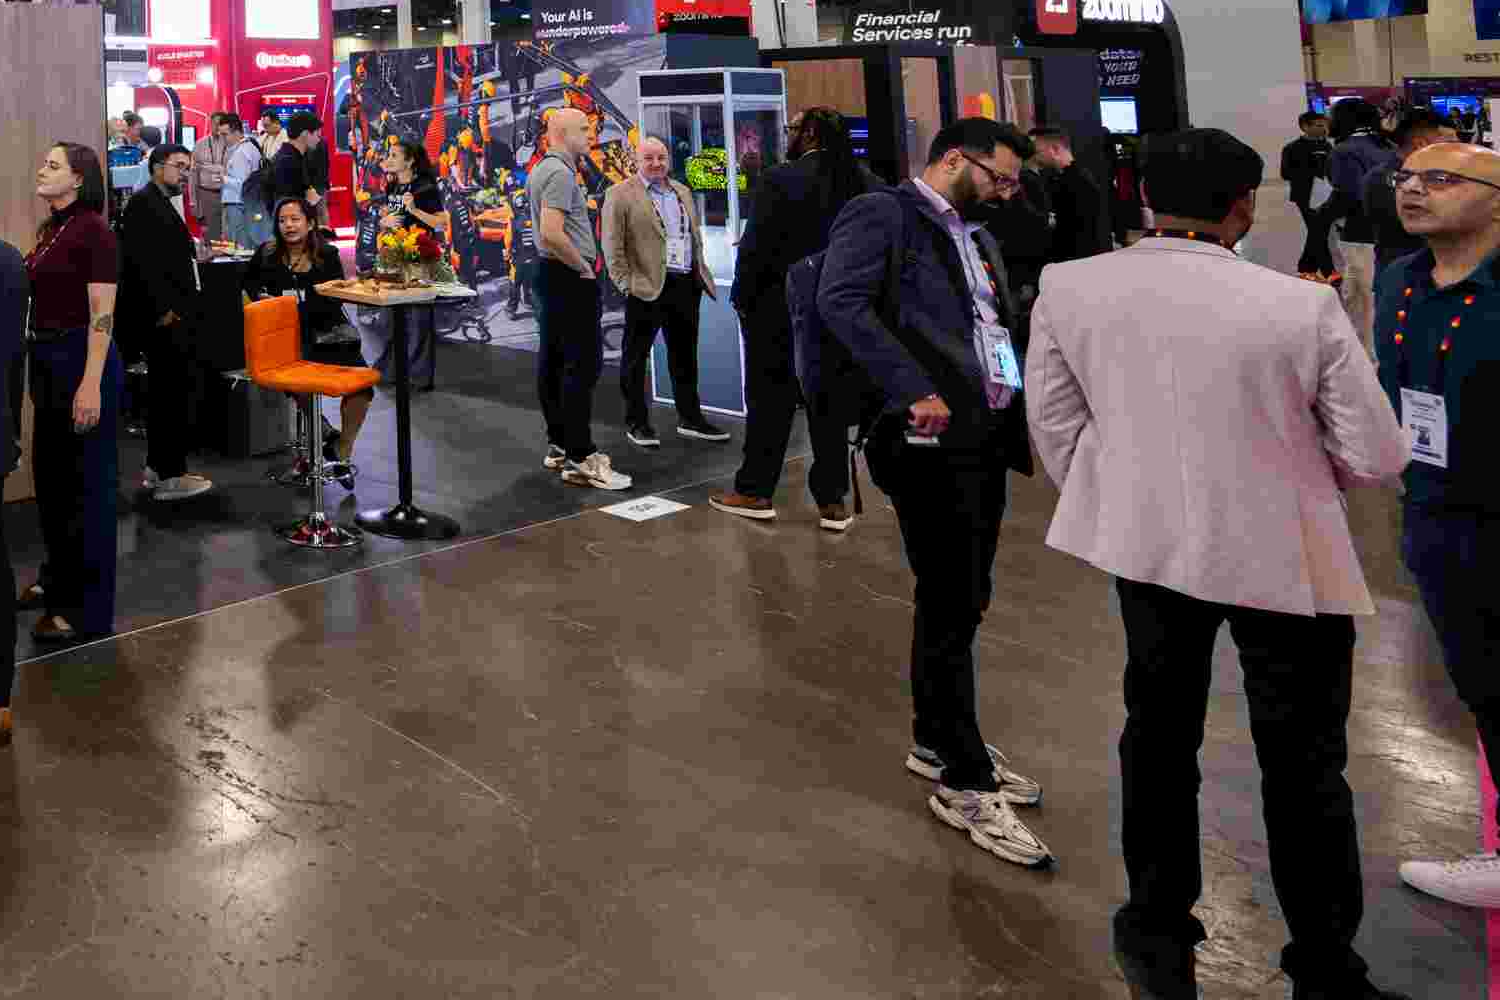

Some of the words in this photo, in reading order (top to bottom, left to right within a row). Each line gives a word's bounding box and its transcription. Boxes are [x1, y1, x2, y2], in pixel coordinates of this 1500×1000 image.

[541, 11, 566, 24] Your
[569, 8, 582, 21] AI
[855, 10, 941, 27] Financial
[852, 26, 934, 43] Services
[938, 26, 972, 39] run
